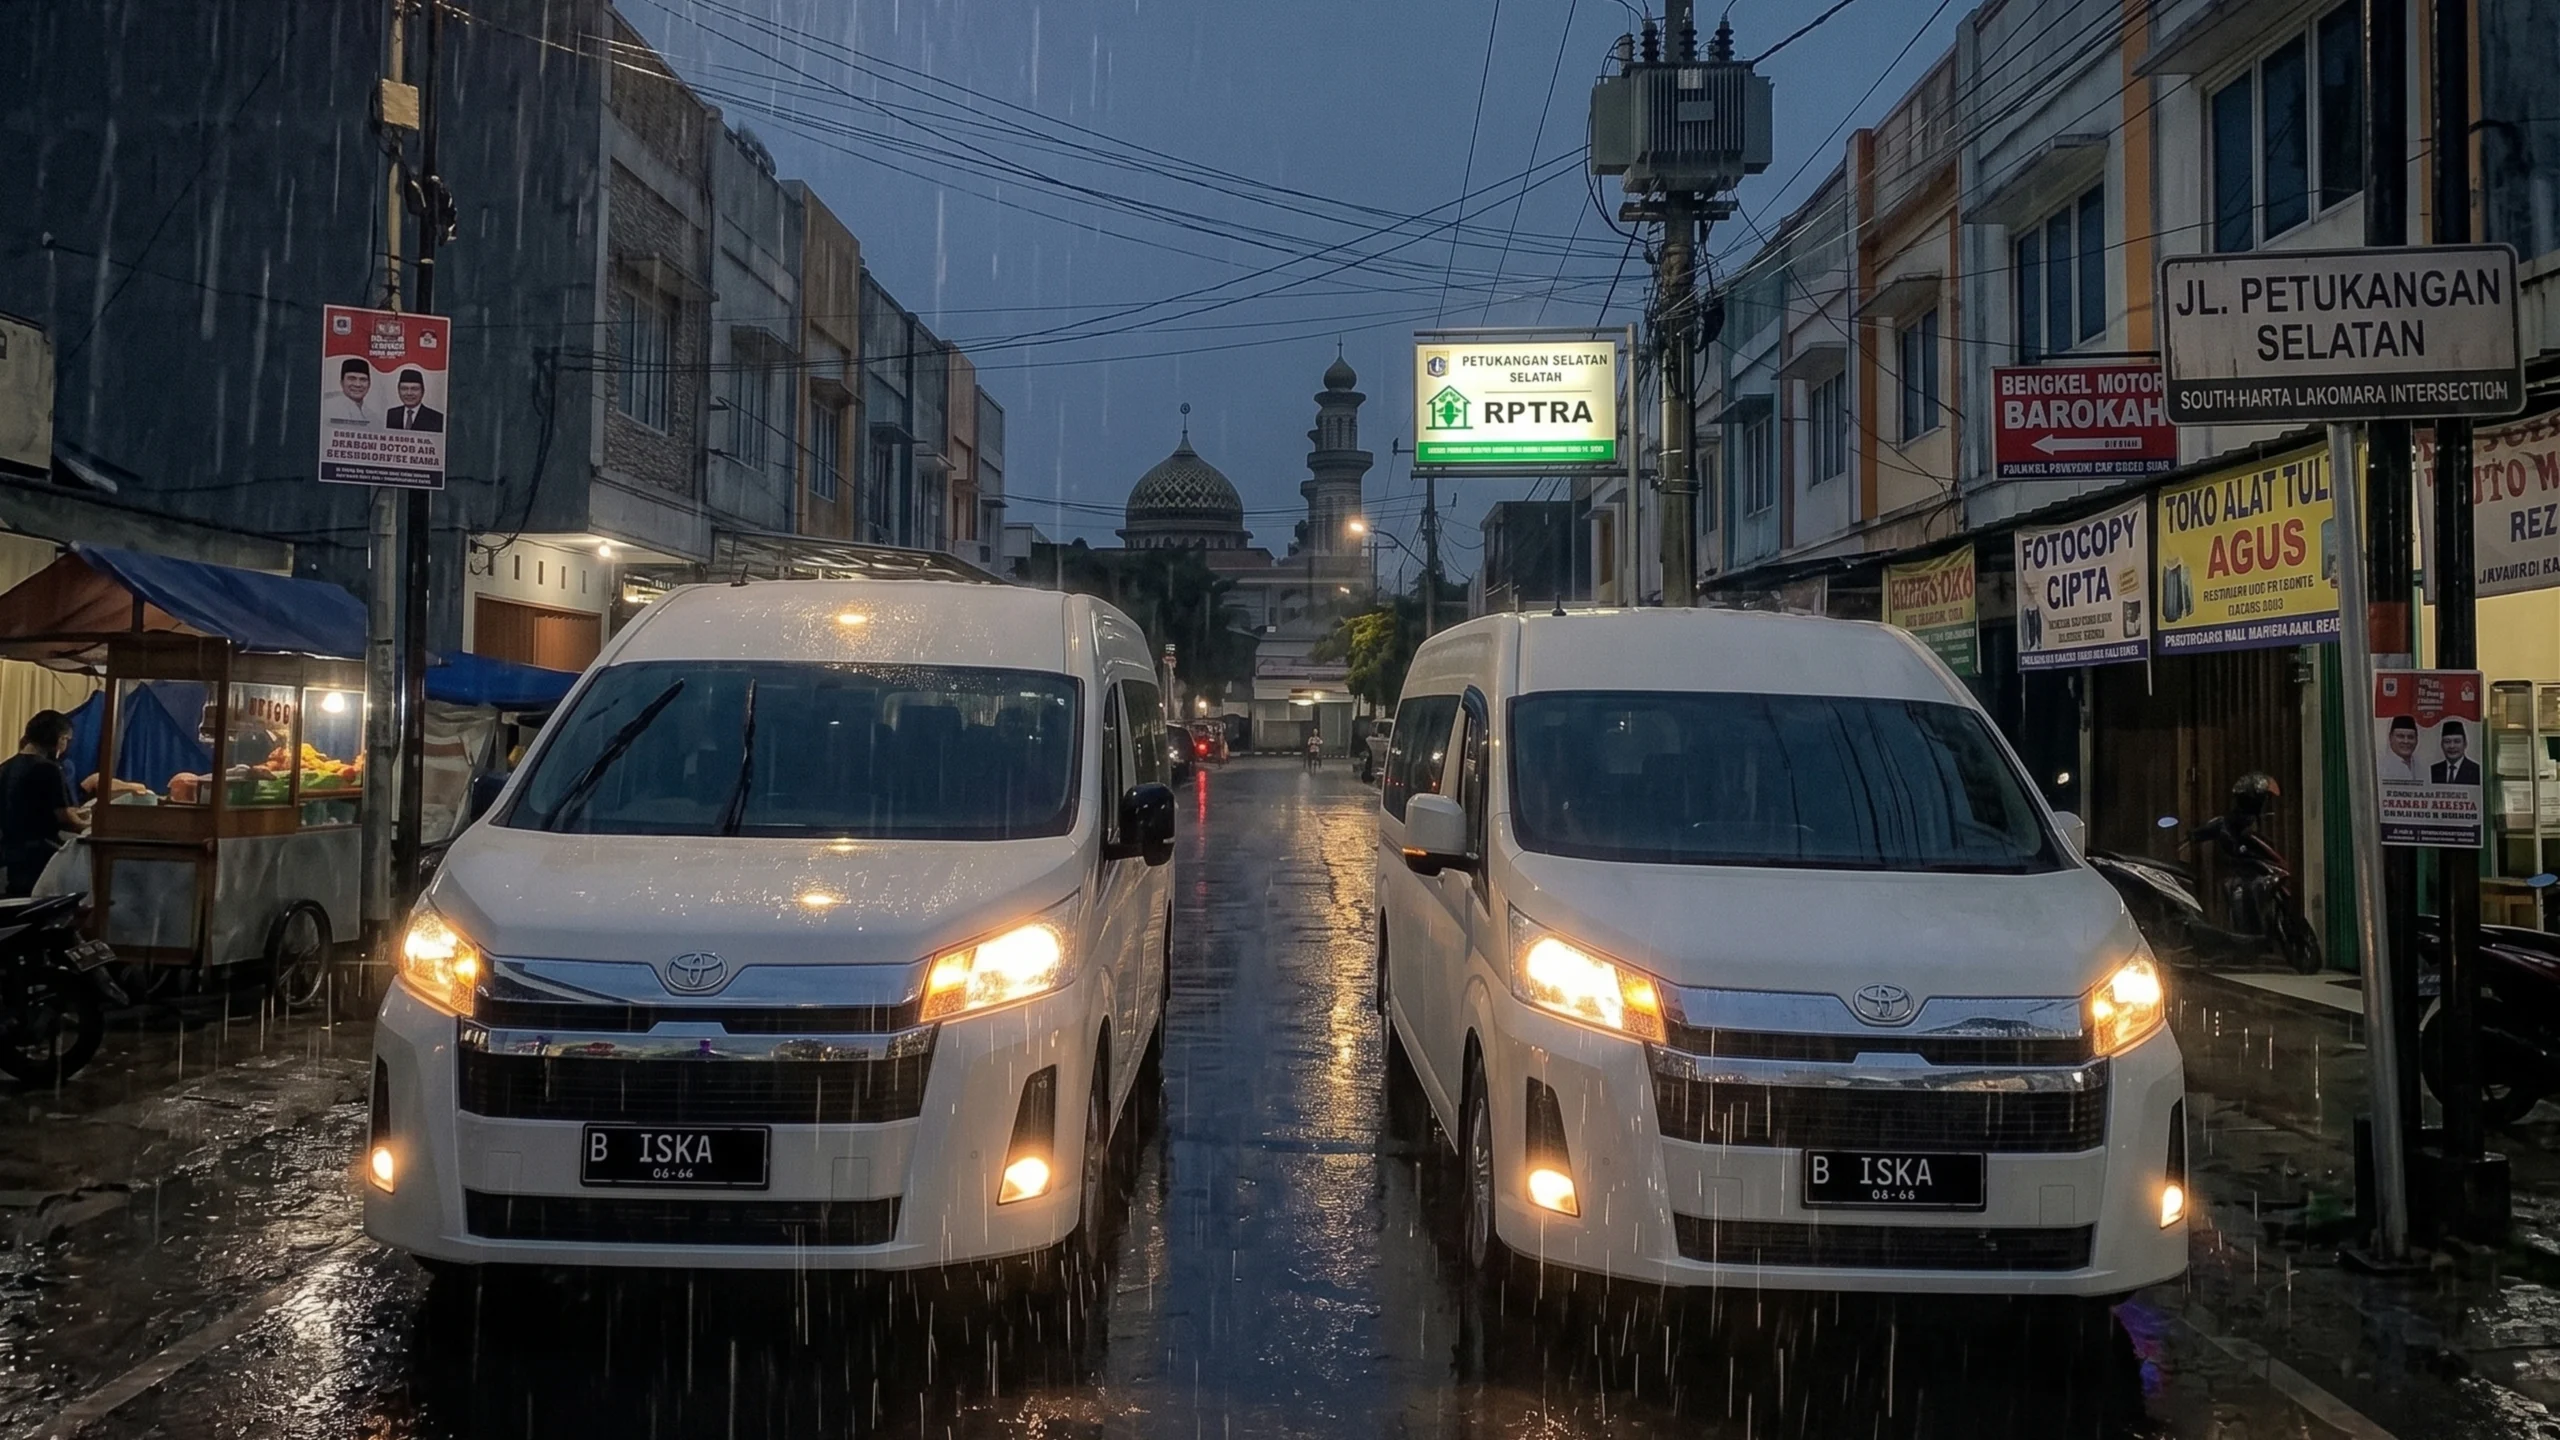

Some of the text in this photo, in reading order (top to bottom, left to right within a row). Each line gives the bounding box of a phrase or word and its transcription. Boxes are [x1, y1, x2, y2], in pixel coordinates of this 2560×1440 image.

[2176, 268, 2501, 316] JL. PETUKANGAN
[2257, 320, 2425, 362] SELATAN
[1462, 354, 1608, 367] PETUKANGAN SELATAN
[2002, 374, 2092, 396] BENGKEL
[2296, 384, 2387, 406] LAKOMARA
[1485, 400, 1593, 424] RPTRA
[2004, 397, 2167, 429] BAROKAH
[2165, 485, 2217, 534] TOKO
[2223, 469, 2277, 522] ALAT
[2022, 511, 2138, 571] FOTOCOPY
[2207, 518, 2307, 579] AGUS
[2047, 566, 2112, 609] CIPTA
[591, 1132, 713, 1164] B ISKA
[1813, 1156, 1932, 1186] B ISKA
